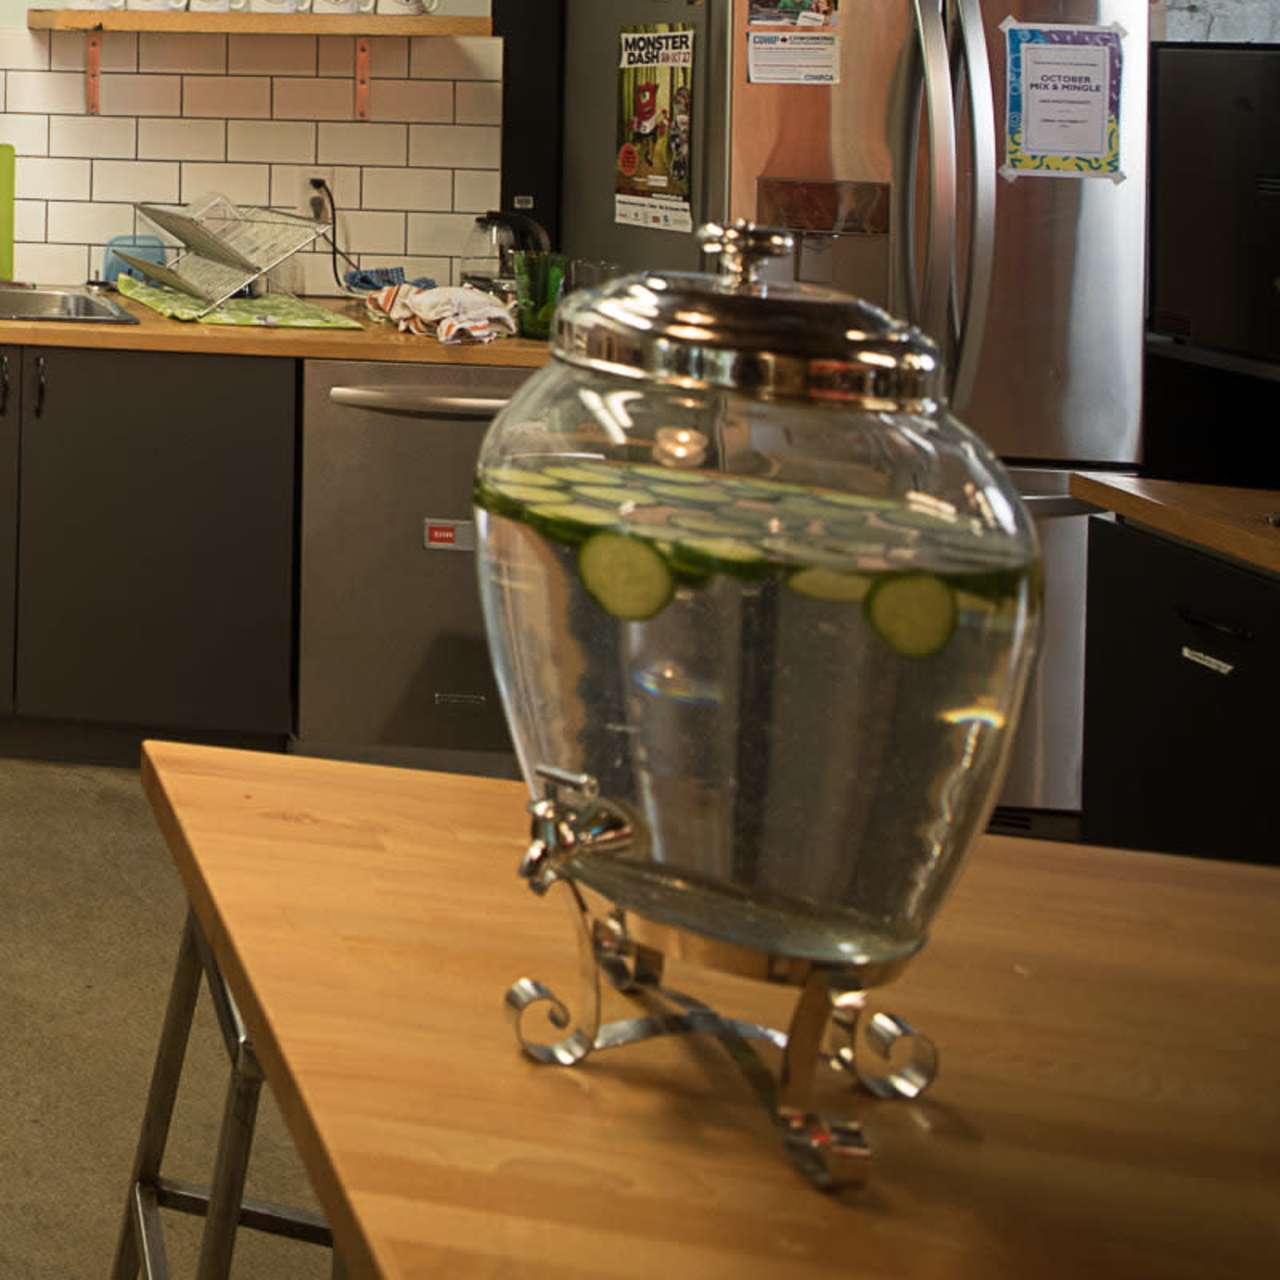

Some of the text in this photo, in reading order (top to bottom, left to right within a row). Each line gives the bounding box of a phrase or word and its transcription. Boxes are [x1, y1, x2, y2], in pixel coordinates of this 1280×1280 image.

[624, 34, 689, 51] MONSTER
[628, 50, 660, 64] DASH
[1040, 74, 1091, 83] OCTOBER
[1030, 82, 1049, 90] MIX
[1062, 83, 1101, 92] MINGLE
